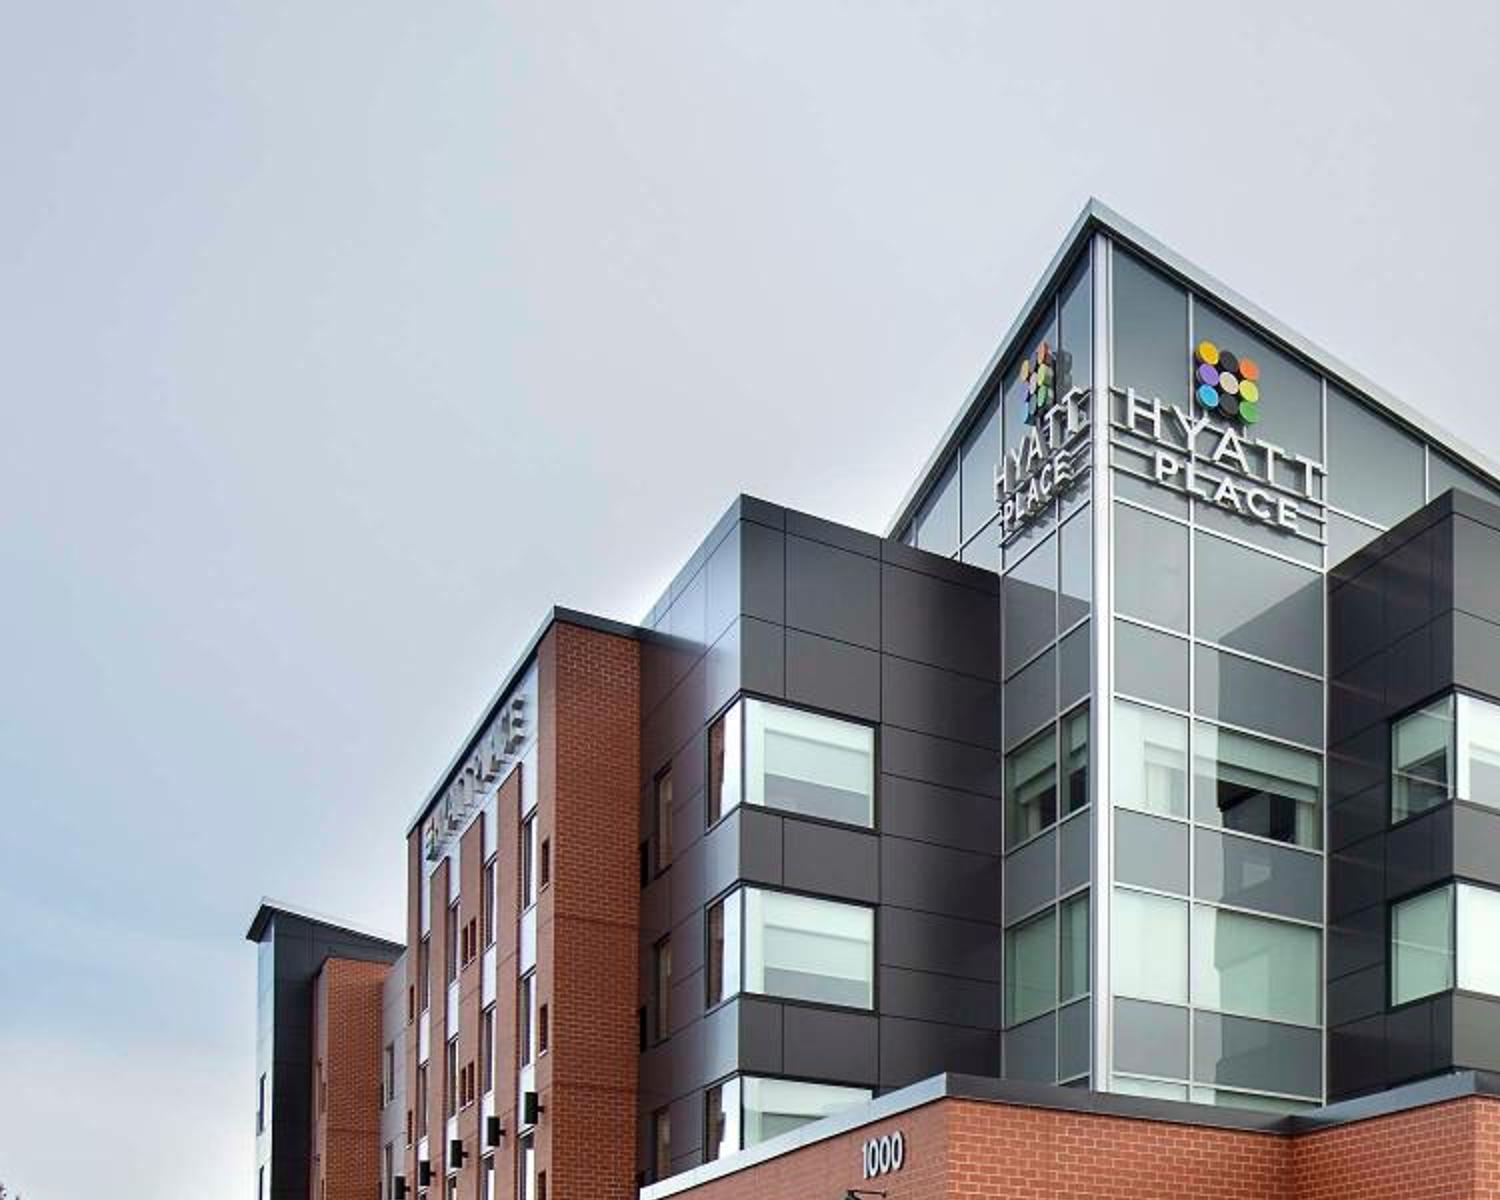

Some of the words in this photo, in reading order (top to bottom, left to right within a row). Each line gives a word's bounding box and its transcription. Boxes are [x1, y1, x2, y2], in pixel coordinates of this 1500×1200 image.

[993, 386, 1084, 502] HYATT
[1126, 387, 1327, 500] HYATT
[1003, 450, 1074, 531] PLACE
[1154, 450, 1300, 531] PLACE
[862, 1131, 903, 1179] 1000
